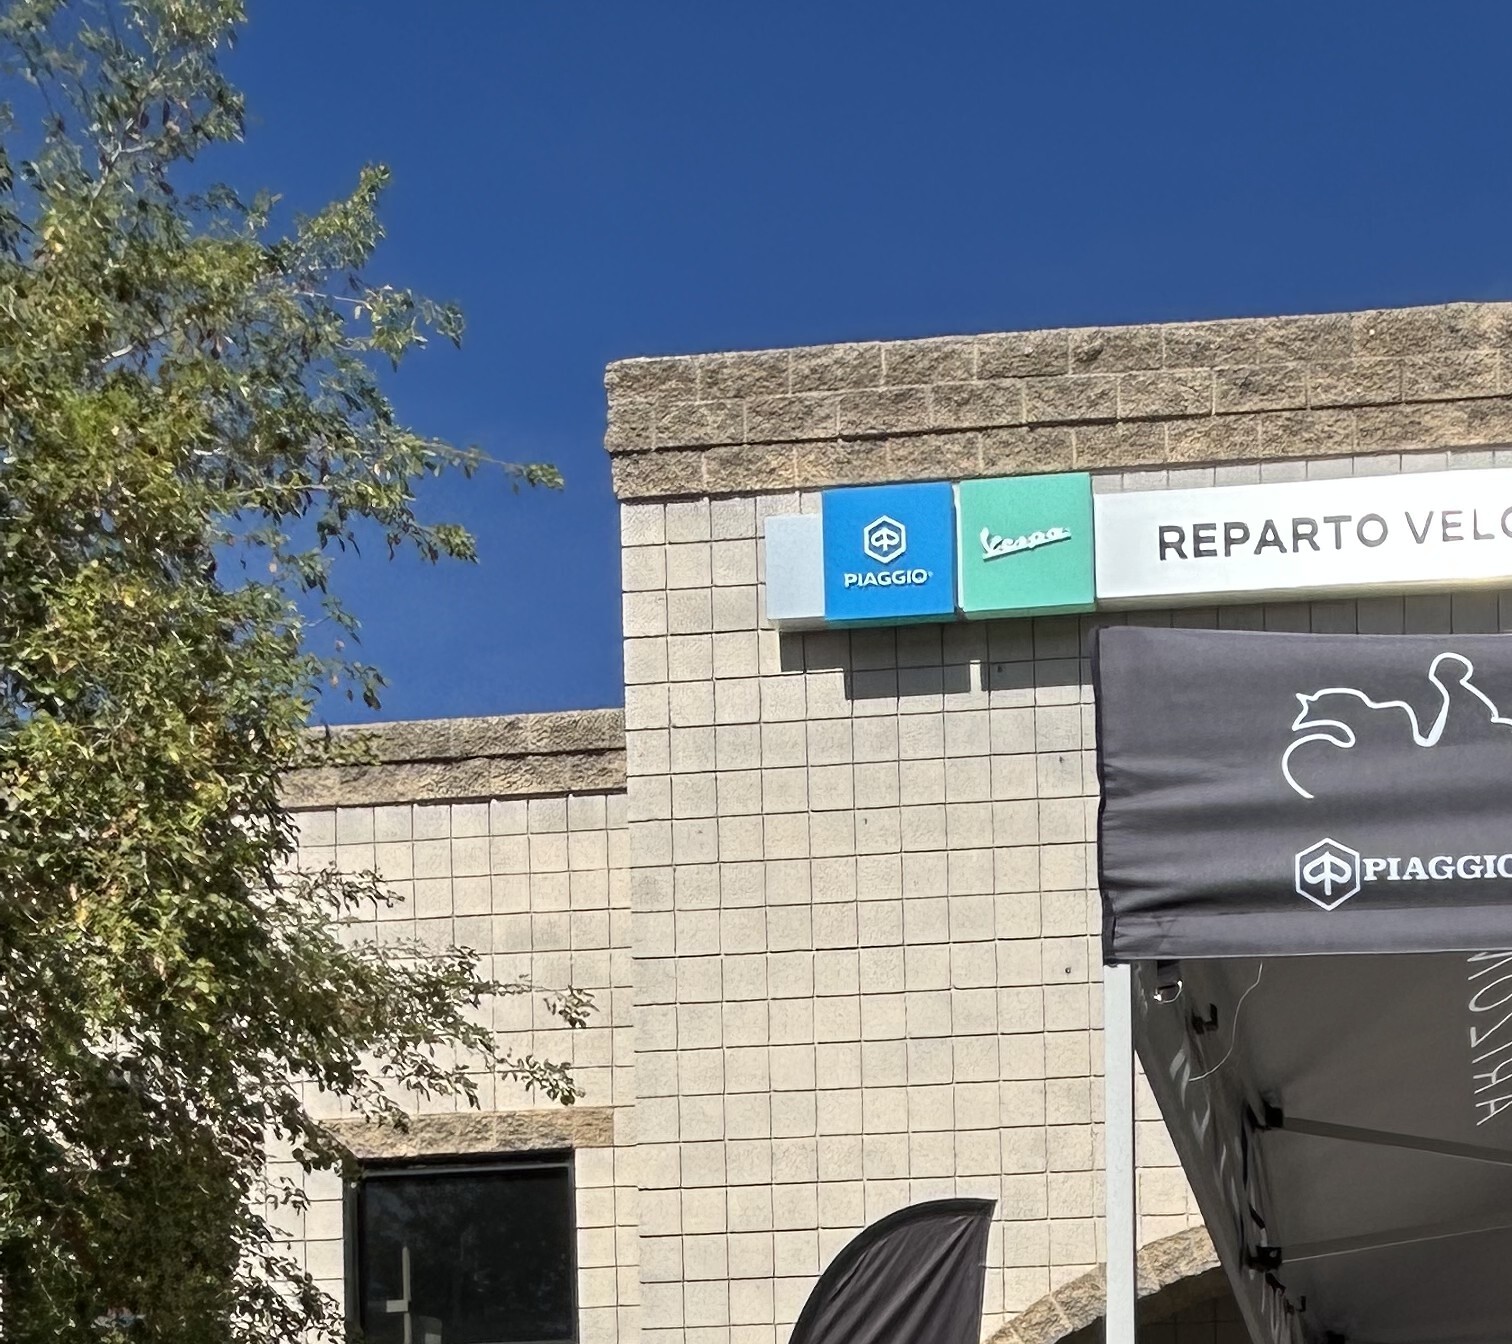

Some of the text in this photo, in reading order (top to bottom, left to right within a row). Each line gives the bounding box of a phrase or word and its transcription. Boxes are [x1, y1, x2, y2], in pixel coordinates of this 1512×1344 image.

[980, 527, 1072, 563] Vespa
[1159, 513, 1390, 562] REPARTO
[844, 568, 928, 588] PIAGGIO
